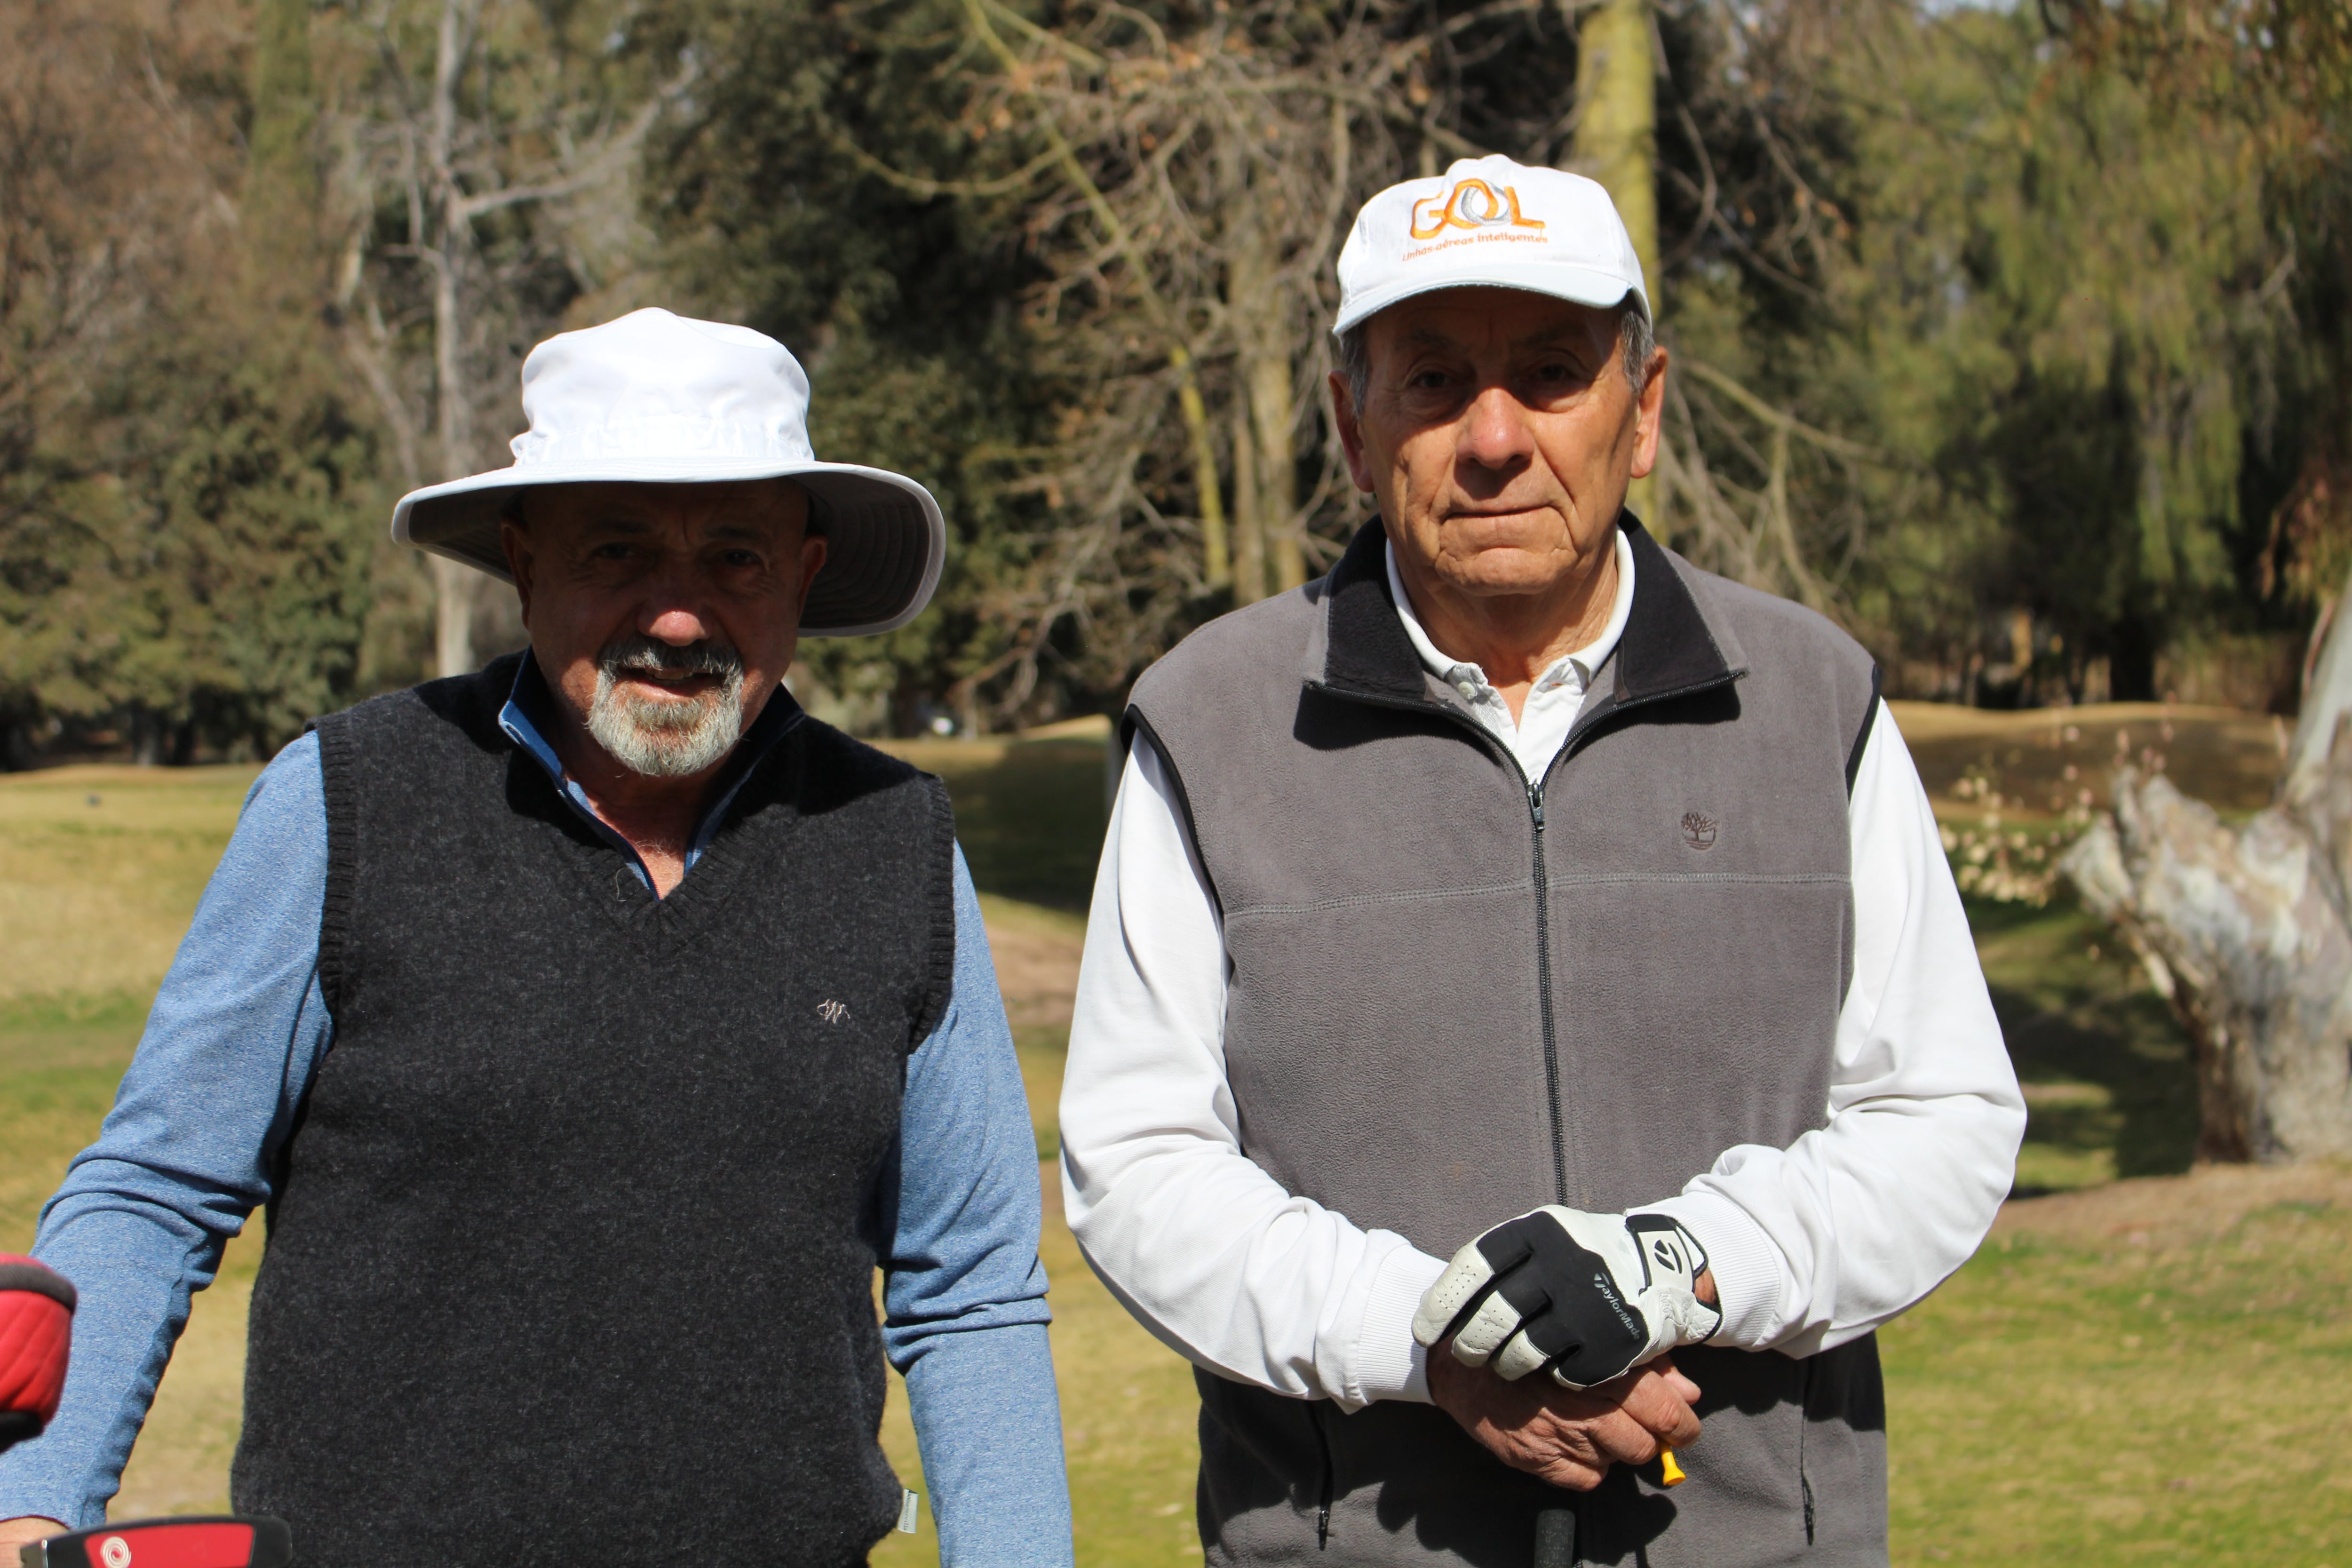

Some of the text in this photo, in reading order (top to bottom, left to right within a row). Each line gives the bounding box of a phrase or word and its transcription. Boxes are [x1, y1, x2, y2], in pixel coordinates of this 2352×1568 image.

[1410, 179, 1545, 239] GOL
[1402, 246, 1433, 262] Linhas
[1594, 1272, 1640, 1340] TaylorMade
